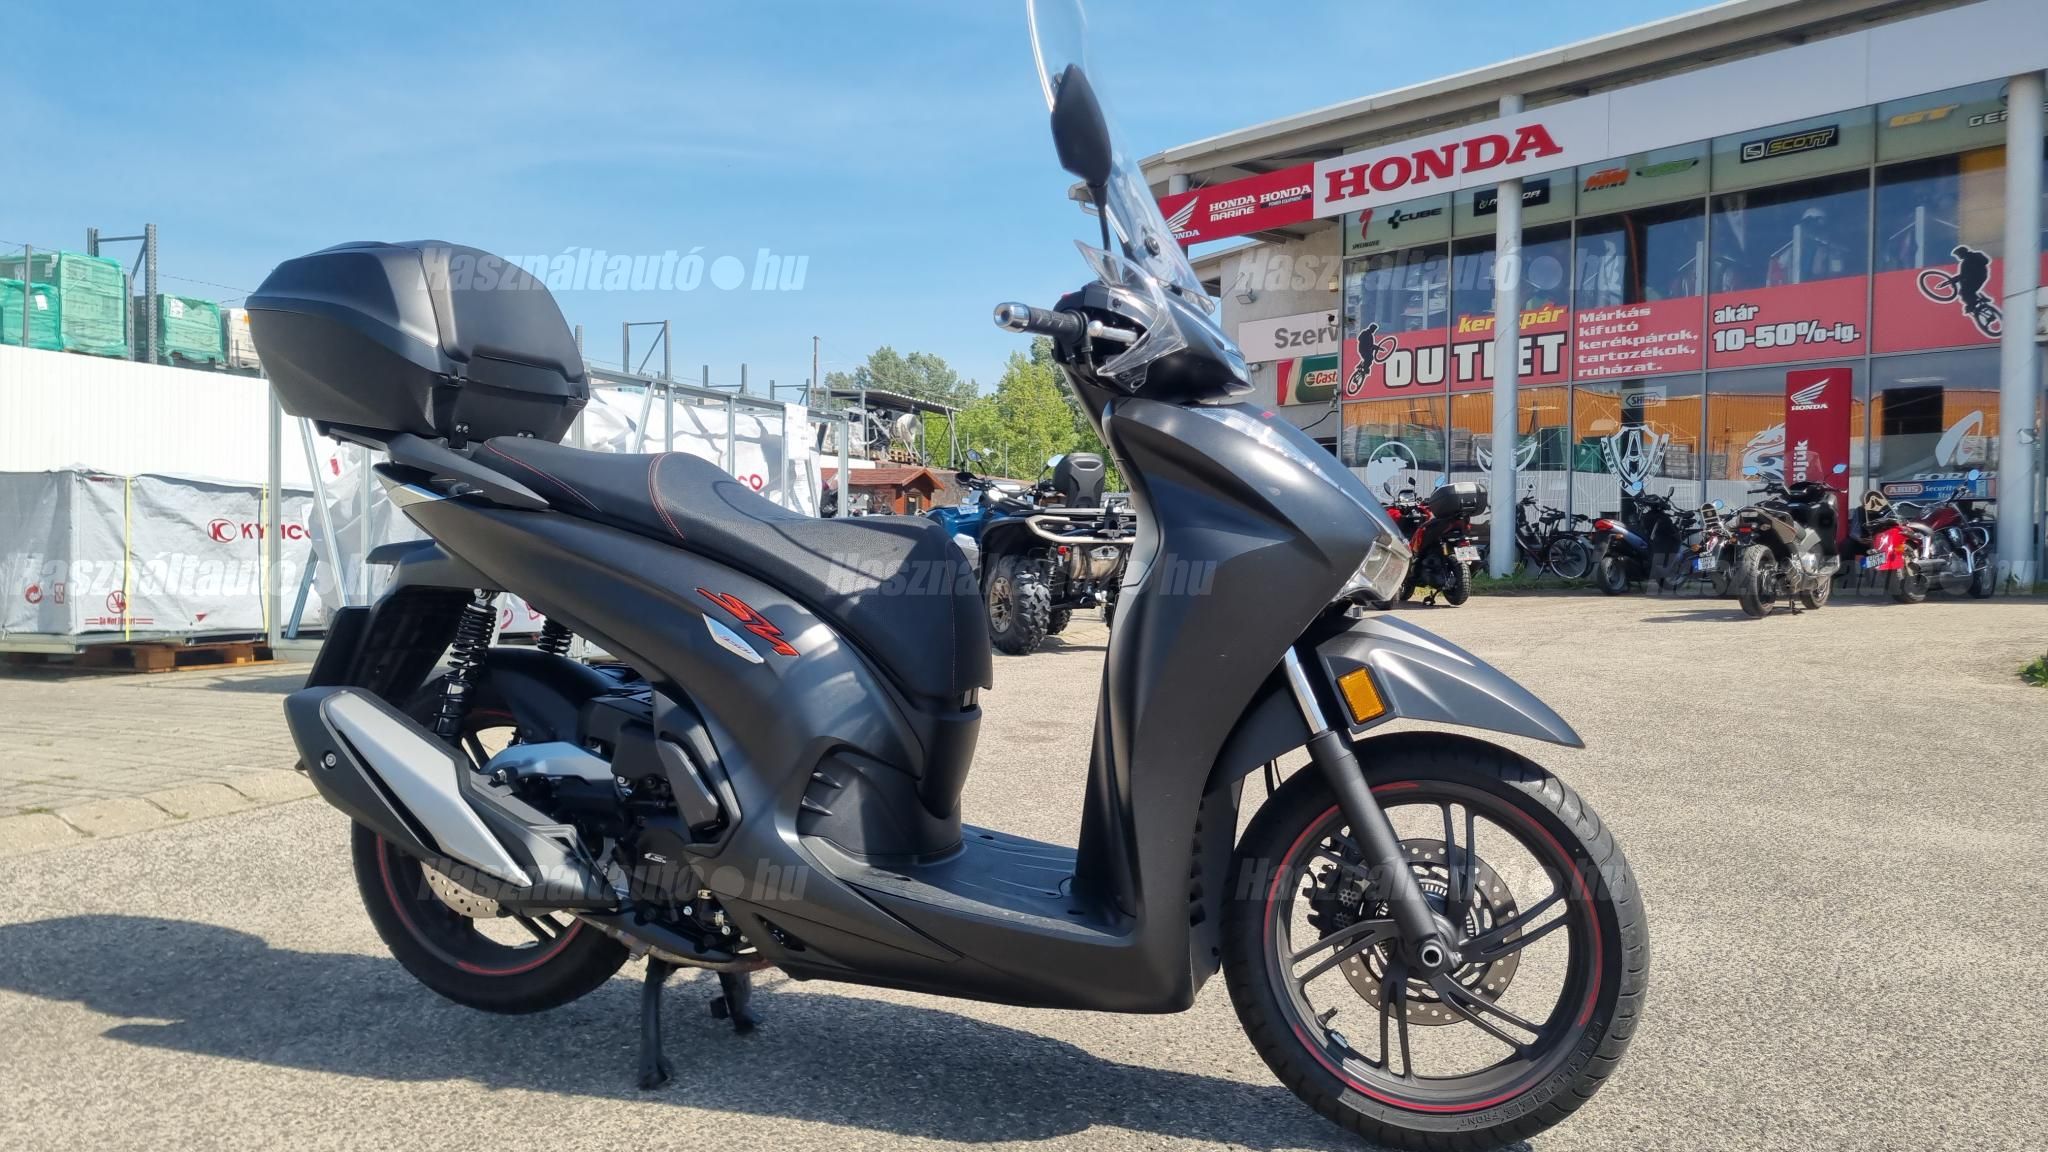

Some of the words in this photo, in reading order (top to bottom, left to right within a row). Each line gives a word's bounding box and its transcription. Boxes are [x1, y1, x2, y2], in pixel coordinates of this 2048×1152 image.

[1770, 131, 1830, 152] SCOTT
[1325, 124, 1563, 203] HONDA
[1259, 185, 1312, 204] HONDA
[1209, 195, 1257, 212] HONDA
[1401, 208, 1442, 222] CUBE
[1173, 228, 1200, 240] ONDA
[1459, 306, 1564, 333] kerpár
[1579, 307, 1651, 323] Márkás
[1714, 304, 1759, 324] akár
[1579, 321, 1638, 337] kifutó
[1713, 320, 1860, 352] 10-50%-ig.
[1579, 330, 1698, 350] kerékpárok,
[1579, 345, 1696, 363] tartozékok,
[1316, 371, 1338, 384] Cast
[1578, 362, 1662, 377] ruházat.
[1791, 402, 1829, 411] HONDA
[241, 523, 311, 540] KYC
